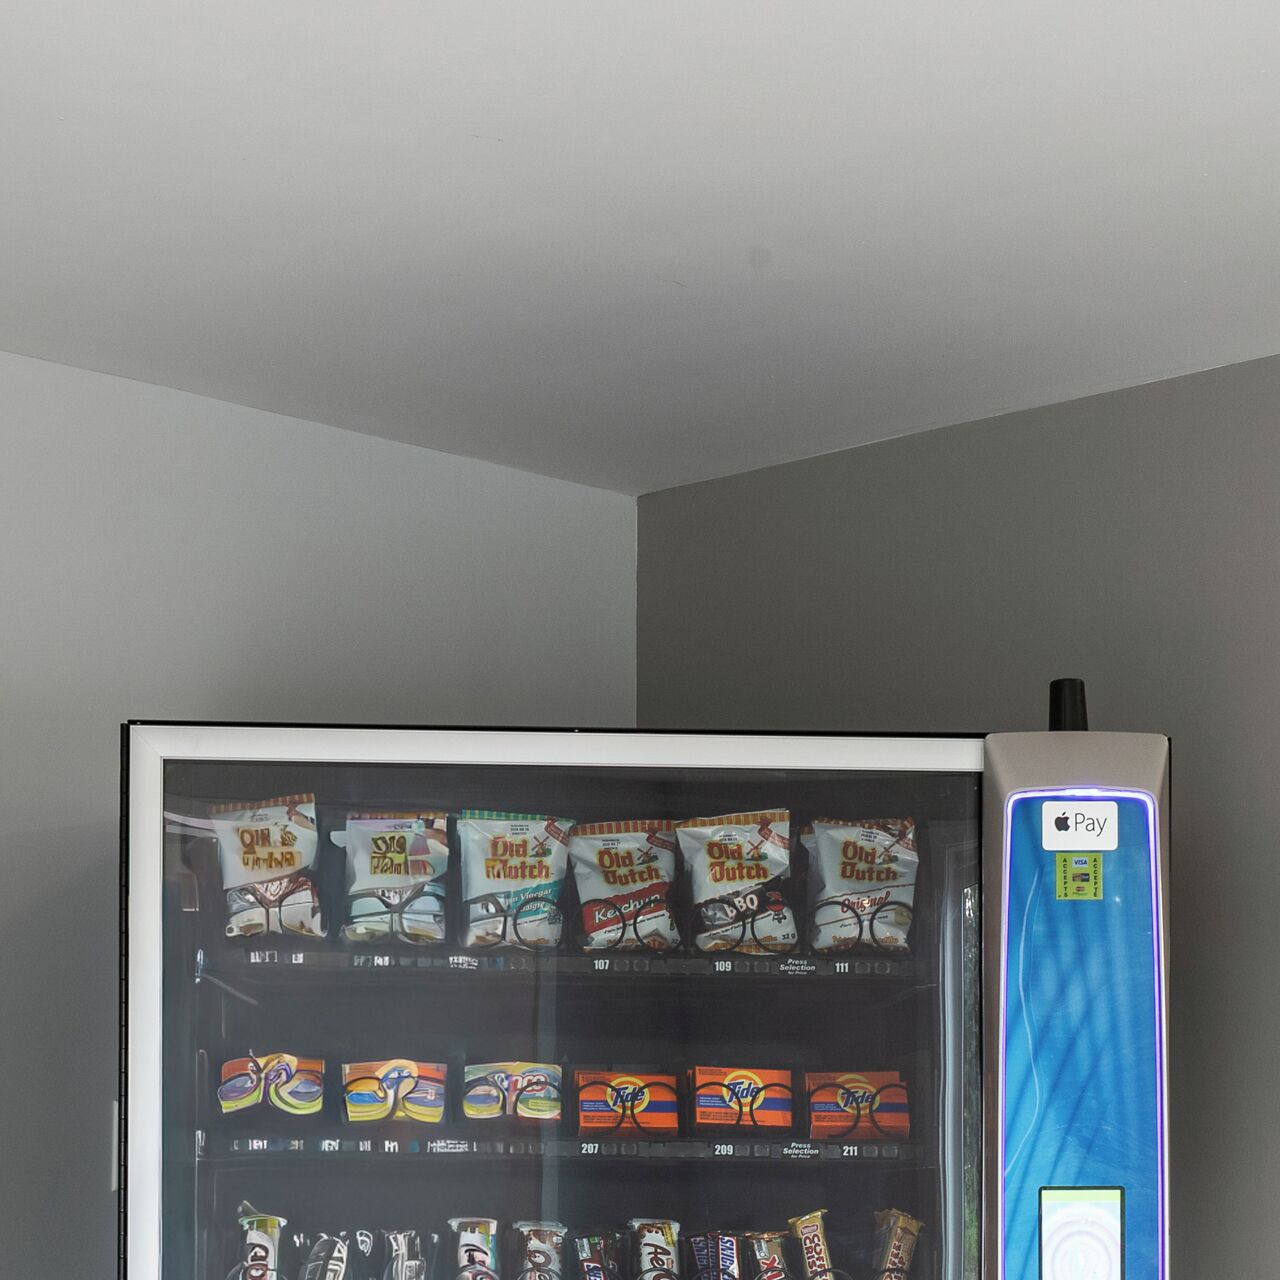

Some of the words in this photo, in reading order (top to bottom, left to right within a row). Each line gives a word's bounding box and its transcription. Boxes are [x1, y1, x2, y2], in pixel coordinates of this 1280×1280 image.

[1075, 813, 1107, 837] Pay
[491, 836, 528, 858] Old
[707, 841, 742, 859] Old
[842, 840, 877, 865] Old
[598, 850, 634, 869] Old
[602, 865, 661, 886] Dutch
[709, 862, 768, 882] Dutch
[841, 861, 897, 881] Dutch
[594, 960, 610, 970] 107
[715, 961, 732, 972] 109
[835, 962, 849, 973] 111
[611, 1085, 645, 1108] Tide
[727, 1080, 761, 1104] Tide
[581, 1143, 599, 1154] 207
[715, 1145, 733, 1155] 209
[843, 1146, 858, 1156] 211
